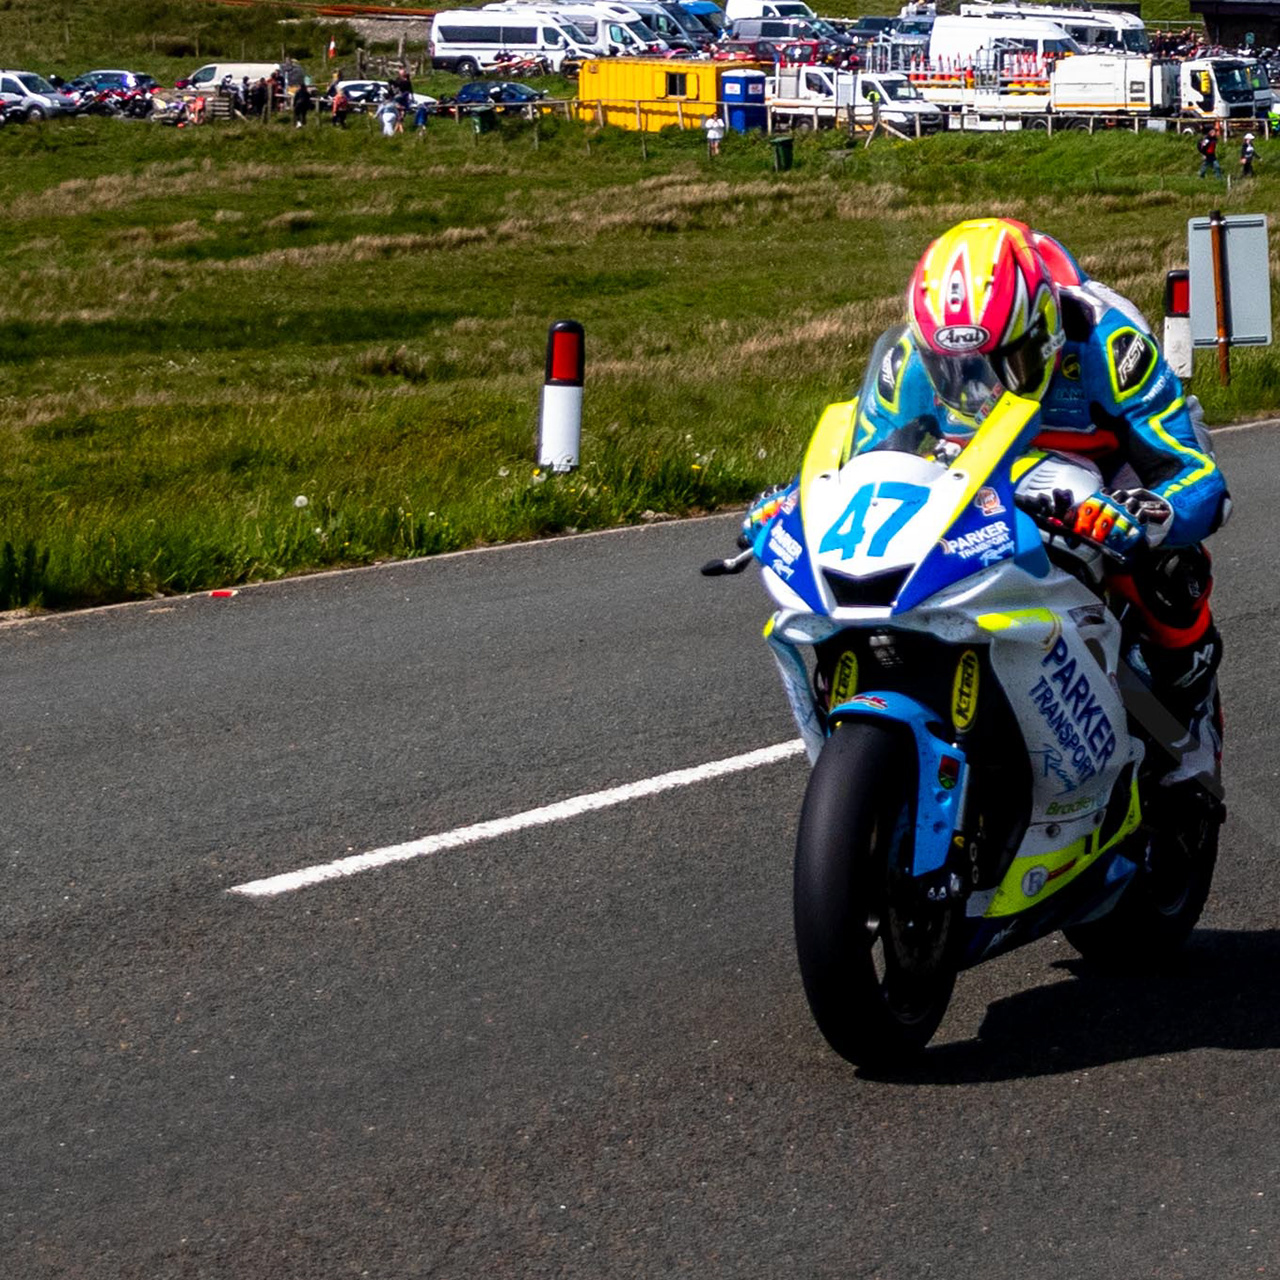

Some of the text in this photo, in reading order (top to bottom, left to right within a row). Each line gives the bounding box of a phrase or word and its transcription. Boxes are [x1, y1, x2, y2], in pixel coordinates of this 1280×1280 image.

[945, 329, 981, 345] Arai
[1117, 332, 1146, 387] RST
[819, 481, 931, 561] 47
[948, 521, 1011, 554] PARKER
[958, 533, 1010, 560] TRANSPORT
[1028, 675, 1097, 786] TRANSPORT
[1041, 635, 1117, 774] PARKER
